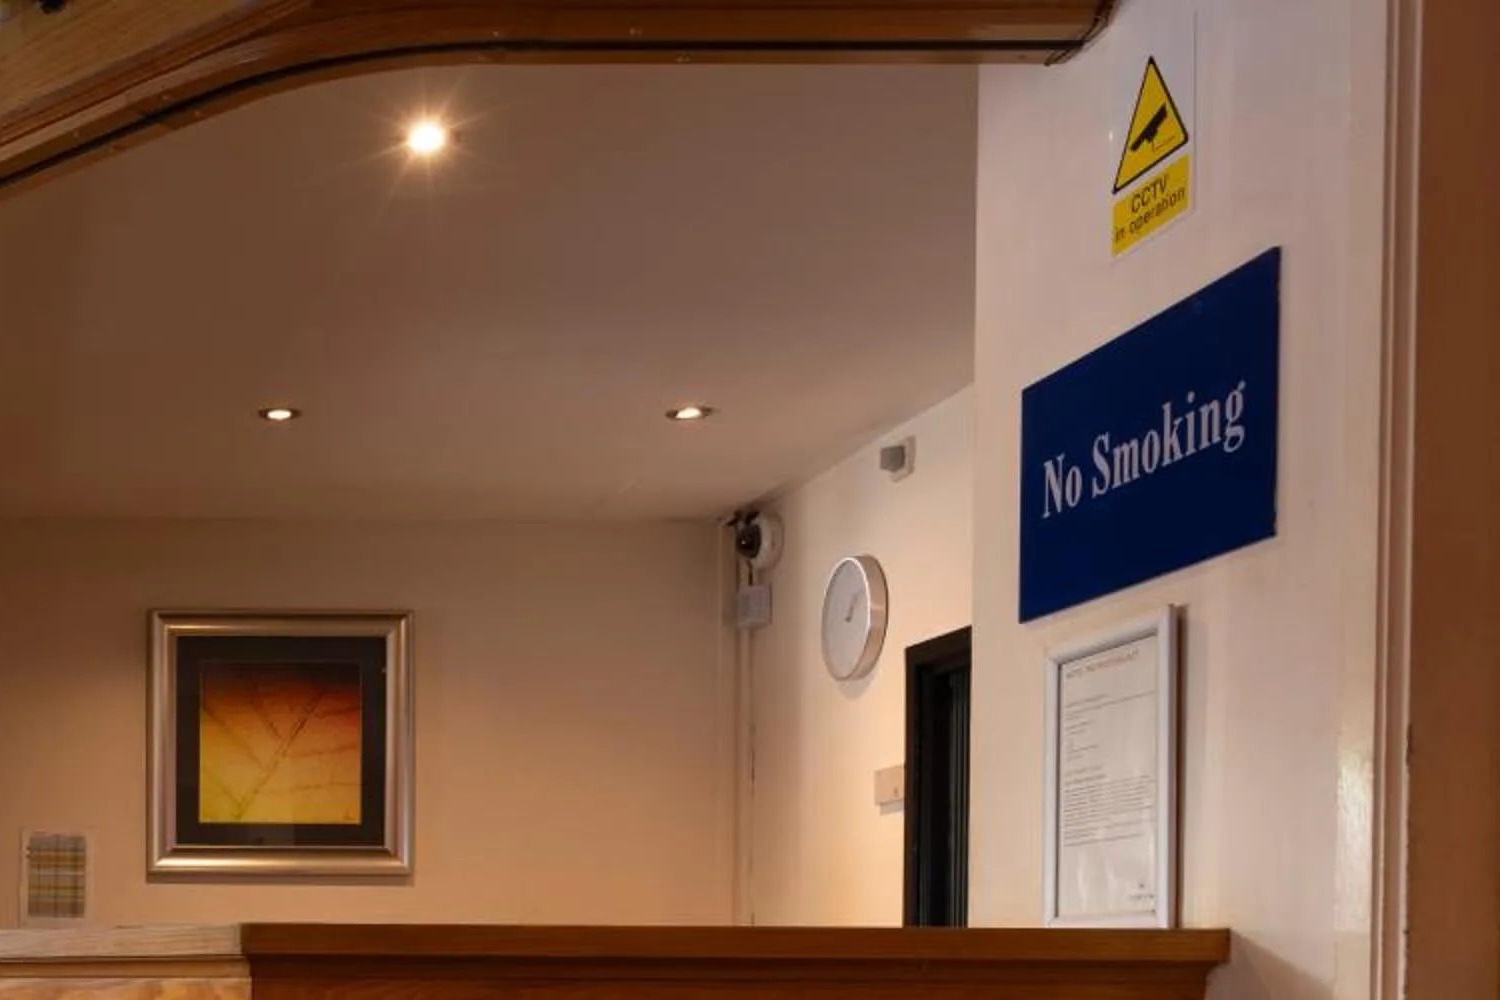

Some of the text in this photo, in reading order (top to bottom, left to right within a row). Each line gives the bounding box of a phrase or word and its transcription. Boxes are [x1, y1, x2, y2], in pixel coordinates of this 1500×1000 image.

[1128, 187, 1185, 234] operation
[1131, 174, 1168, 213] CCTV
[1041, 379, 1246, 519] No Smoking
